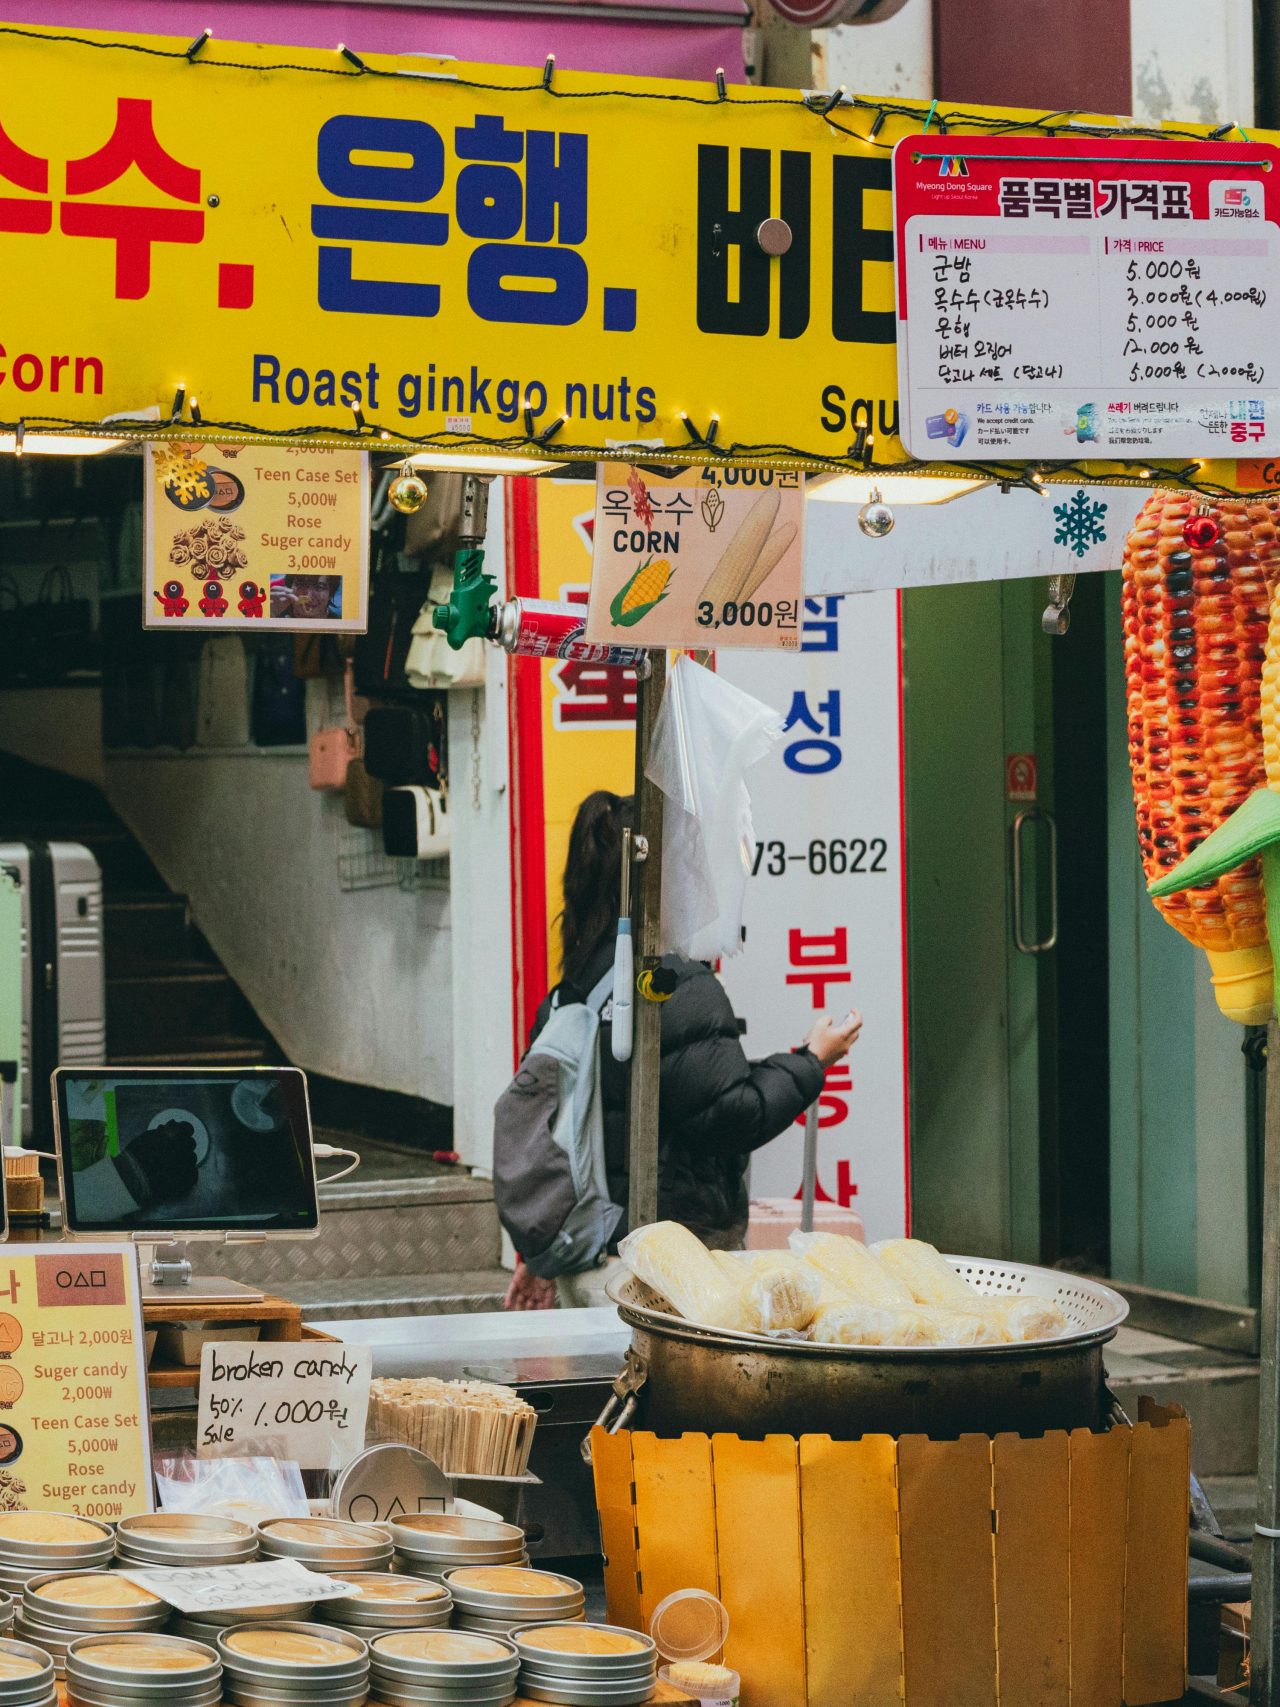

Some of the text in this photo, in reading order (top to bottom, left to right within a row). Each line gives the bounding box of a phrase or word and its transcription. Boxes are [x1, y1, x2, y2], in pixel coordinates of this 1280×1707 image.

[916, 182, 993, 192] Myeong Dong Square
[1001, 181, 1191, 220] 품목별 가격표
[1214, 208, 1260, 218] 카드가능업소
[928, 237, 986, 250] 메뉴 MENU
[1113, 240, 1164, 253] 가격 PRICE
[933, 255, 972, 283] 군밤
[935, 314, 971, 339] 은행
[939, 341, 1012, 361] 버터 오징어
[938, 365, 975, 384] 달고나
[253, 354, 380, 407] Roast
[398, 364, 548, 423] ginkgo
[565, 375, 657, 423] nuts
[977, 403, 992, 414] 카드
[995, 403, 1011, 414] 사용
[1108, 402, 1131, 414] 쓰레기
[1230, 422, 1266, 443] 중구
[254, 467, 358, 483] Teen Case Set
[287, 515, 322, 528] Rose
[261, 533, 352, 551] Suger candy
[613, 530, 680, 553] CORN
[697, 600, 798, 629] 3,000원
[32, 1329, 133, 1347] 달고나 2,000원
[34, 1362, 128, 1381] Suger candy
[211, 1350, 358, 1384] broken candy
[210, 1394, 243, 1419] 50%
[31, 1413, 139, 1431] Teen Case Set
[68, 1462, 105, 1476] Rose
[42, 1480, 136, 1500] Suger candy
